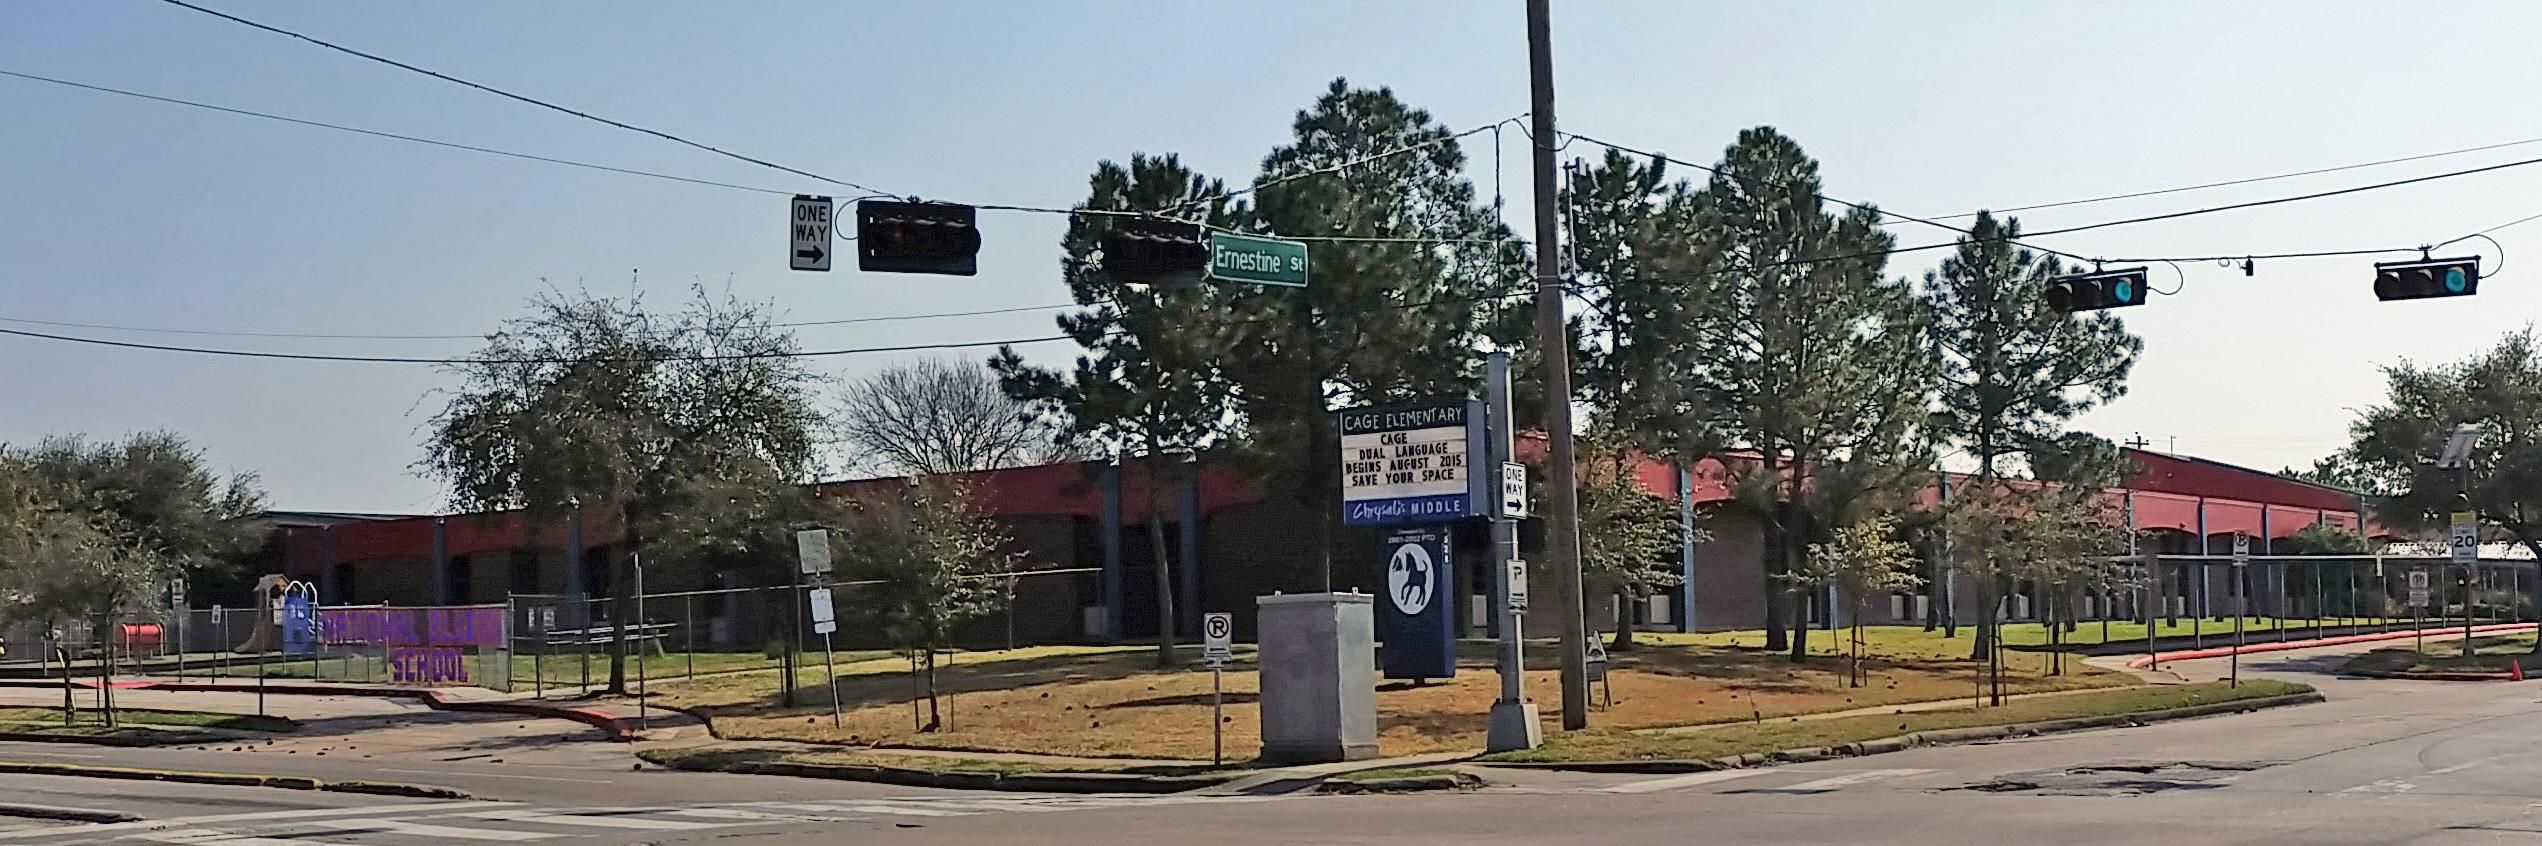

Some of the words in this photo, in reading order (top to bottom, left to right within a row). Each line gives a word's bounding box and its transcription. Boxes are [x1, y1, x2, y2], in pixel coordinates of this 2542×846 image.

[797, 204, 827, 222] ONE
[795, 224, 827, 242] WAY
[1216, 244, 1281, 273] Ernestine
[1290, 256, 1304, 272] St
[1344, 413, 1379, 431] CAGE
[1386, 407, 1461, 428] ELEMENTARY
[1380, 433, 1408, 445] CAGE
[1359, 447, 1385, 460] DUAL
[1395, 442, 1448, 458] LANGUAGE
[1345, 460, 1382, 474] BEGINS
[1389, 457, 1429, 471] AUGUST
[1440, 454, 1461, 467] 2015
[1352, 474, 1378, 487] SAVE
[1385, 472, 1414, 484] YOUR
[1422, 468, 1454, 482] SPACE
[1506, 467, 1523, 482] ONE
[1506, 482, 1523, 496] WAY
[1411, 500, 1461, 515] MIDDLE
[2454, 535, 2475, 548] 20
[393, 649, 468, 682] SCHOOL
